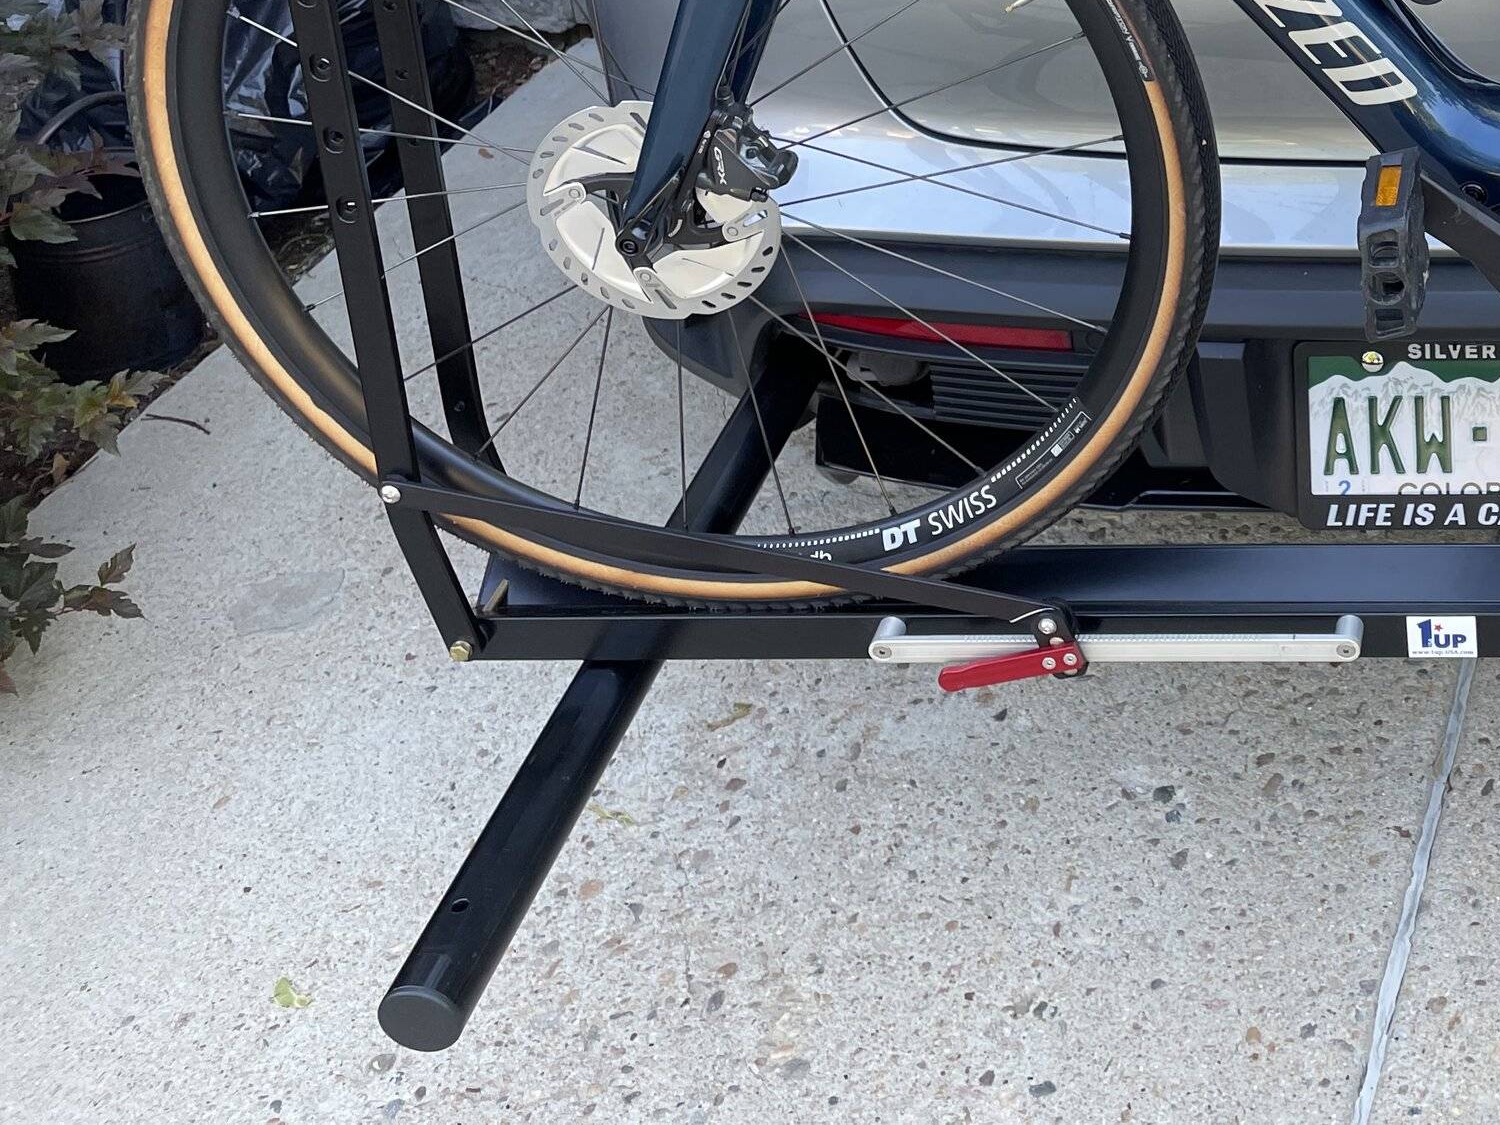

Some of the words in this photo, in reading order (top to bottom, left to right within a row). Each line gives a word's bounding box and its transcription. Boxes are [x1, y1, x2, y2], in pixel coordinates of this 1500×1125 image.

[714, 146, 728, 185] GRX
[1407, 343, 1497, 360] SILVER
[881, 520, 921, 552] DT
[928, 484, 997, 536] SWISS
[1326, 504, 1396, 526] LIFE
[1402, 504, 1435, 526] IS
[1443, 503, 1468, 526] A
